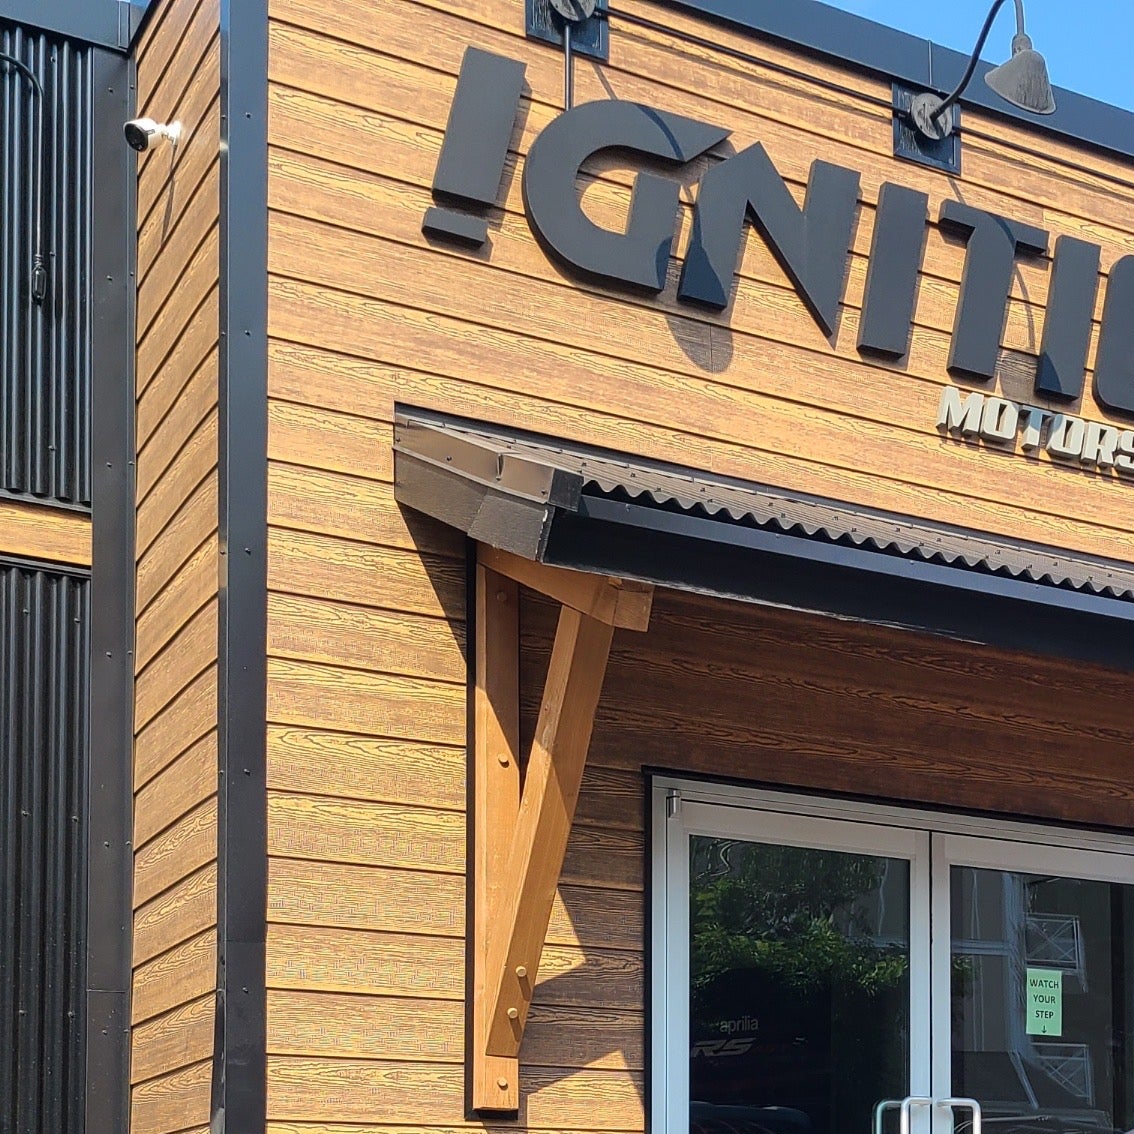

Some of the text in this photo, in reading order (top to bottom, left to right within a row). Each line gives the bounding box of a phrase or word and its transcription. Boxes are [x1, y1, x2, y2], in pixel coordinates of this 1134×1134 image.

[1029, 979, 1059, 989] WATCH
[1033, 994, 1056, 1004] YOUR
[1035, 1010, 1054, 1019] STEP
[719, 1015, 759, 1034] aprilia
